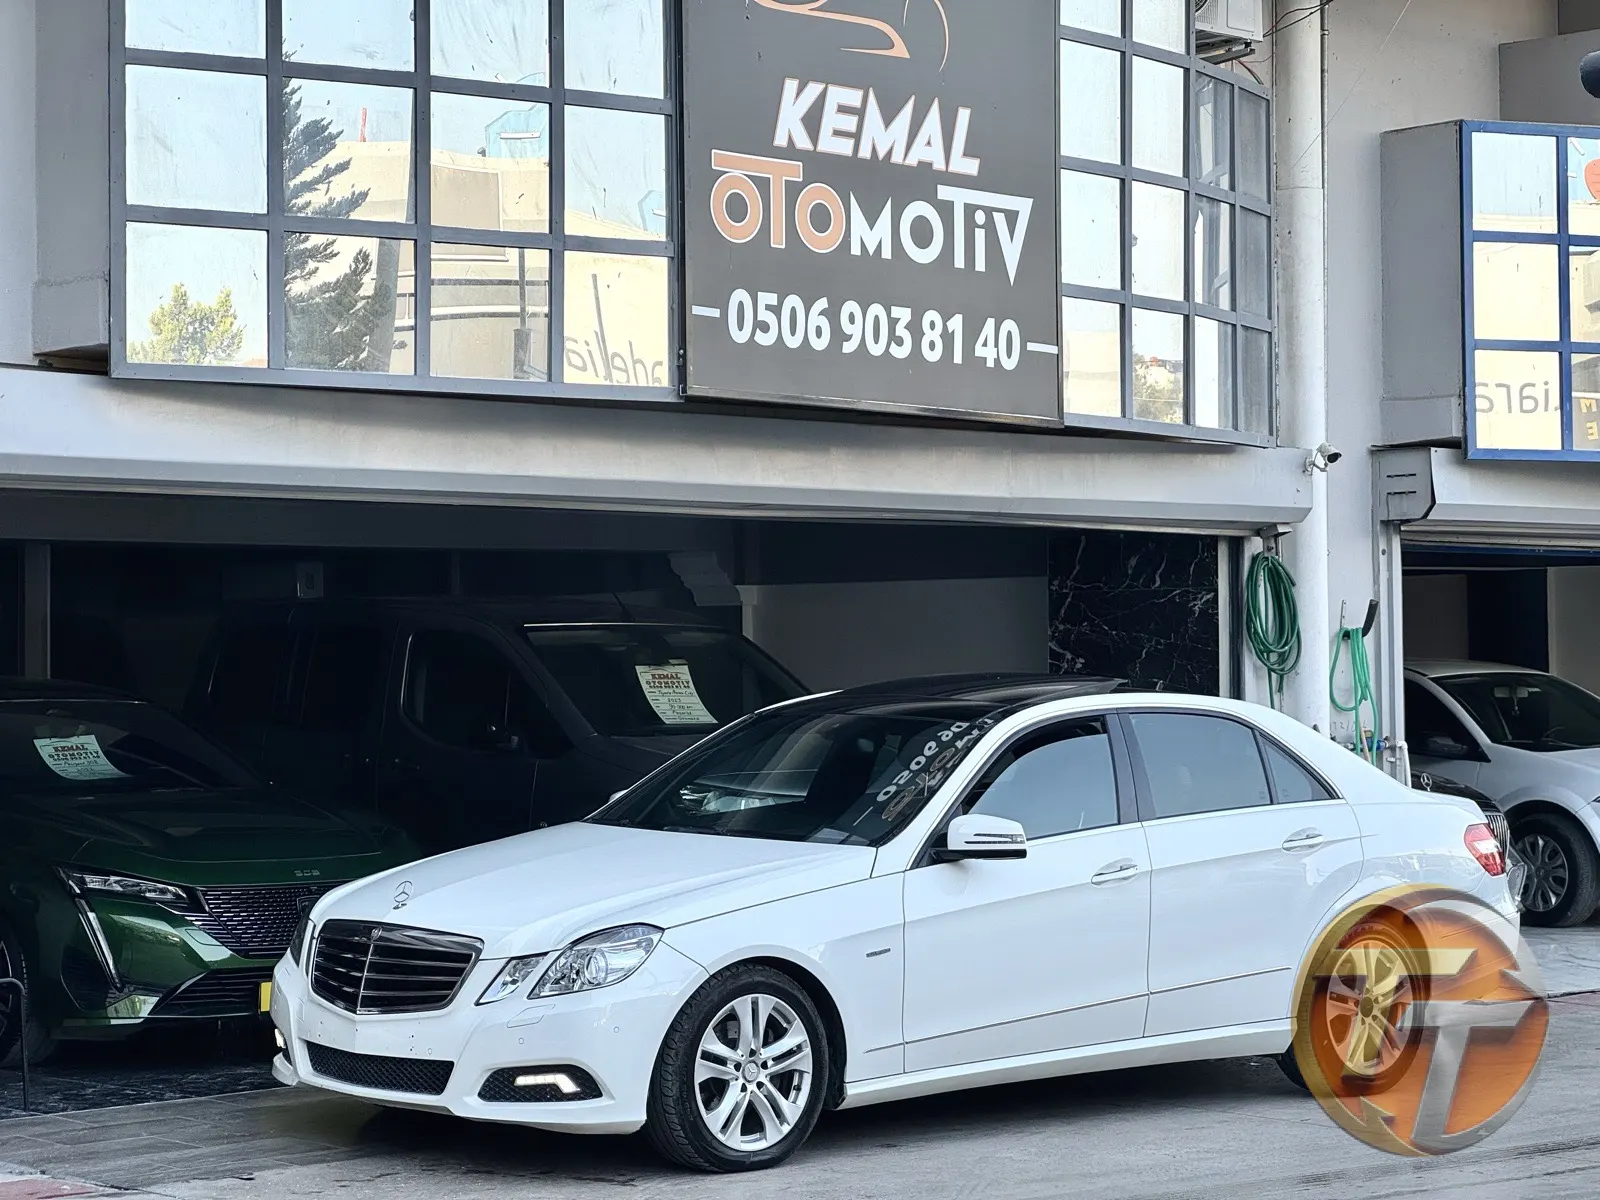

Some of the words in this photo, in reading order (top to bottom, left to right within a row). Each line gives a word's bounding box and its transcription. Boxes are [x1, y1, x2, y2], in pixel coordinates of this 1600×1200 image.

[773, 77, 981, 176] KEMAL
[727, 288, 831, 351] 0506
[839, 299, 913, 359] 903
[920, 309, 964, 365] 81
[974, 317, 1021, 371] 40
